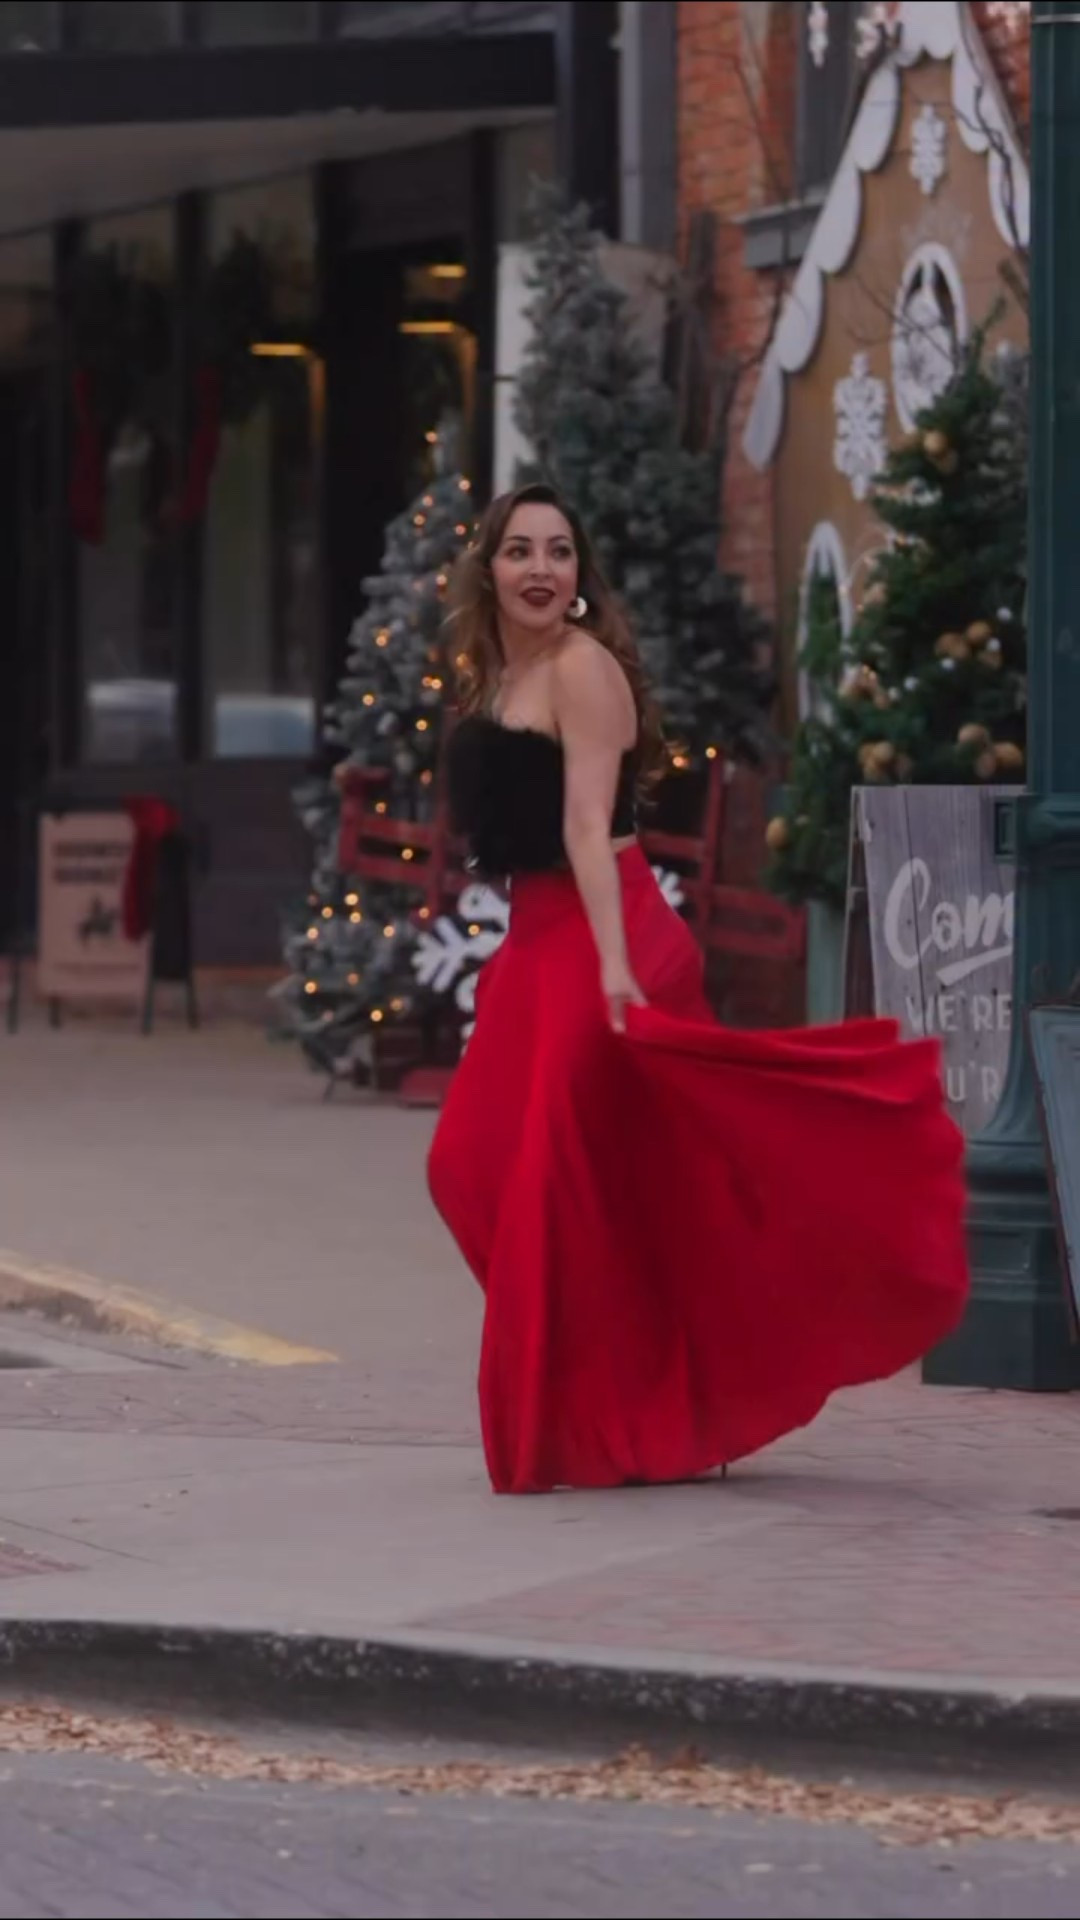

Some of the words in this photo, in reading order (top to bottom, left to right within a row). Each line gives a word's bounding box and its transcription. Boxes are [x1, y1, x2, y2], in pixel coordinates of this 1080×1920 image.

[884, 857, 1014, 969] Com
[905, 991, 1012, 1032] WE'RE
[946, 1060, 1002, 1102] U'R
